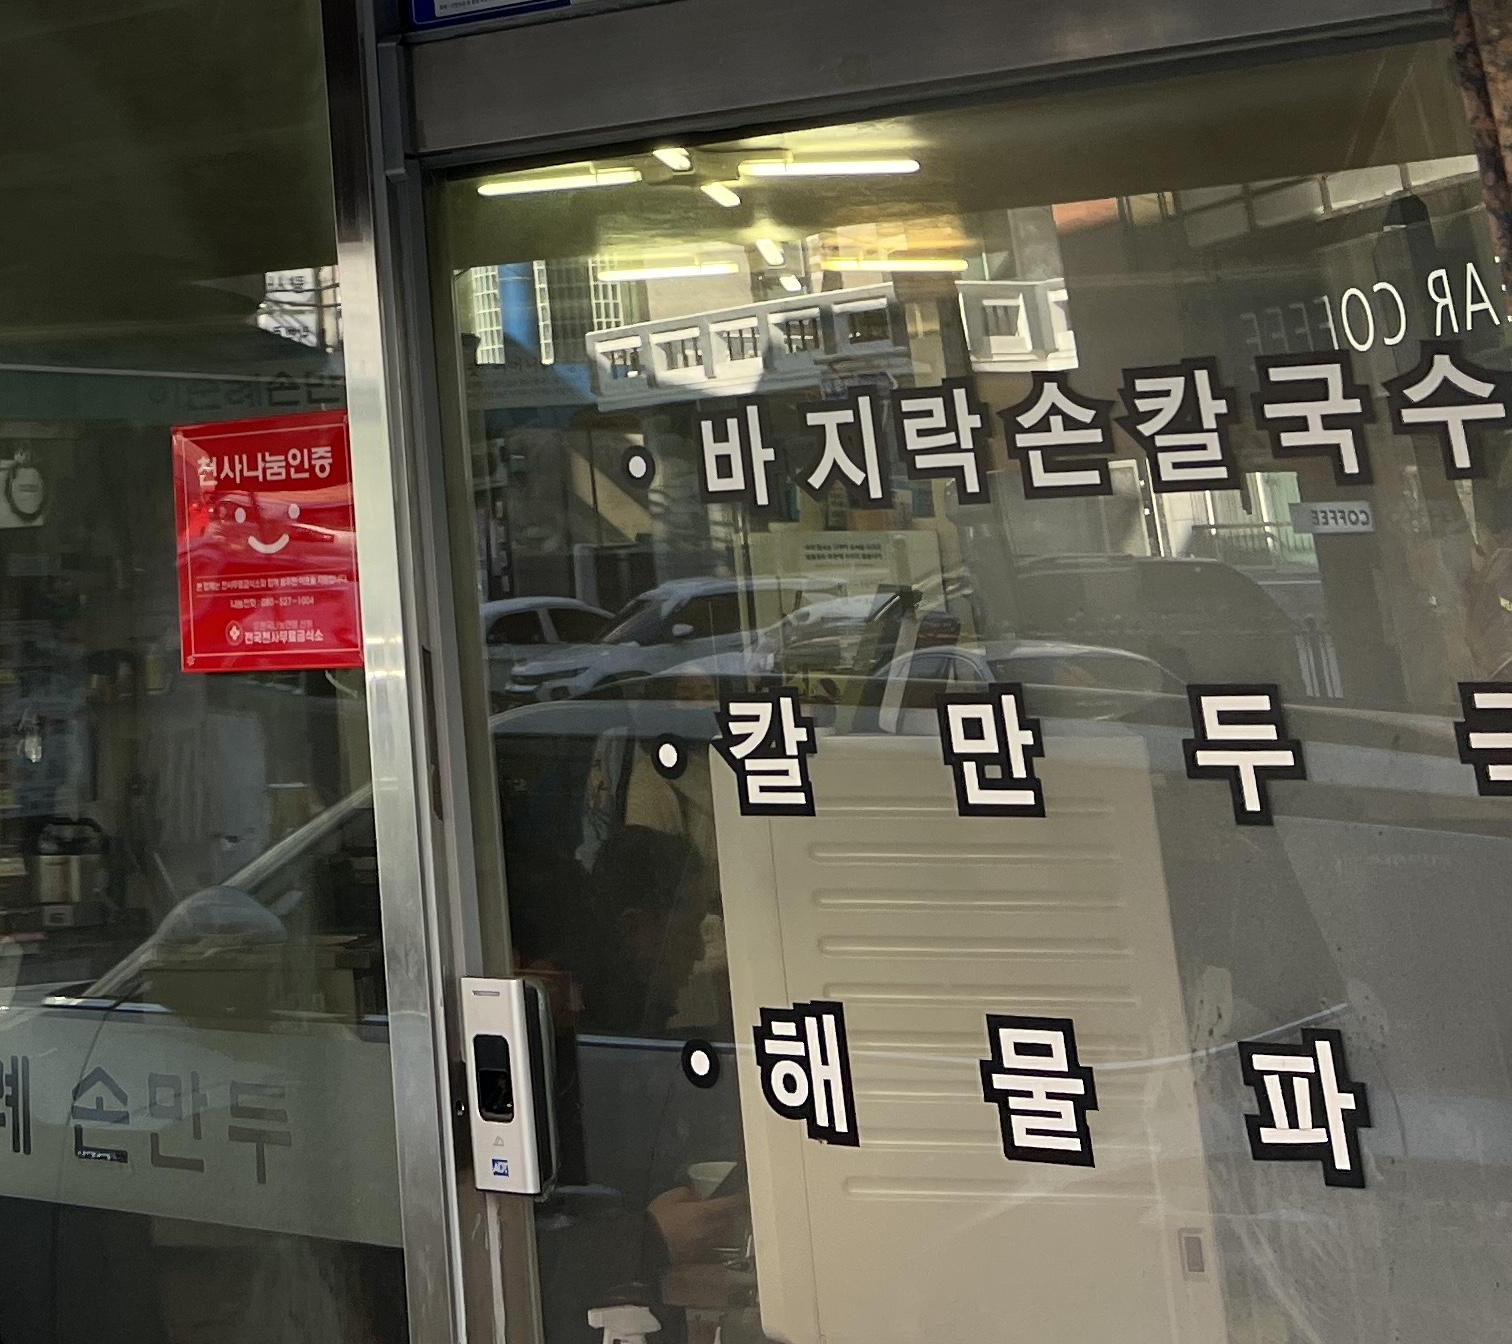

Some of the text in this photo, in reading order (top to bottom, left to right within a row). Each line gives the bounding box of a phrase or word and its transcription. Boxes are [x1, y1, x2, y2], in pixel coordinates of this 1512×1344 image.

[198, 446, 333, 487] 천사나눔인증
[699, 353, 1507, 507] 바지락손칼국수
[70, 1065, 292, 1185] 손만두
